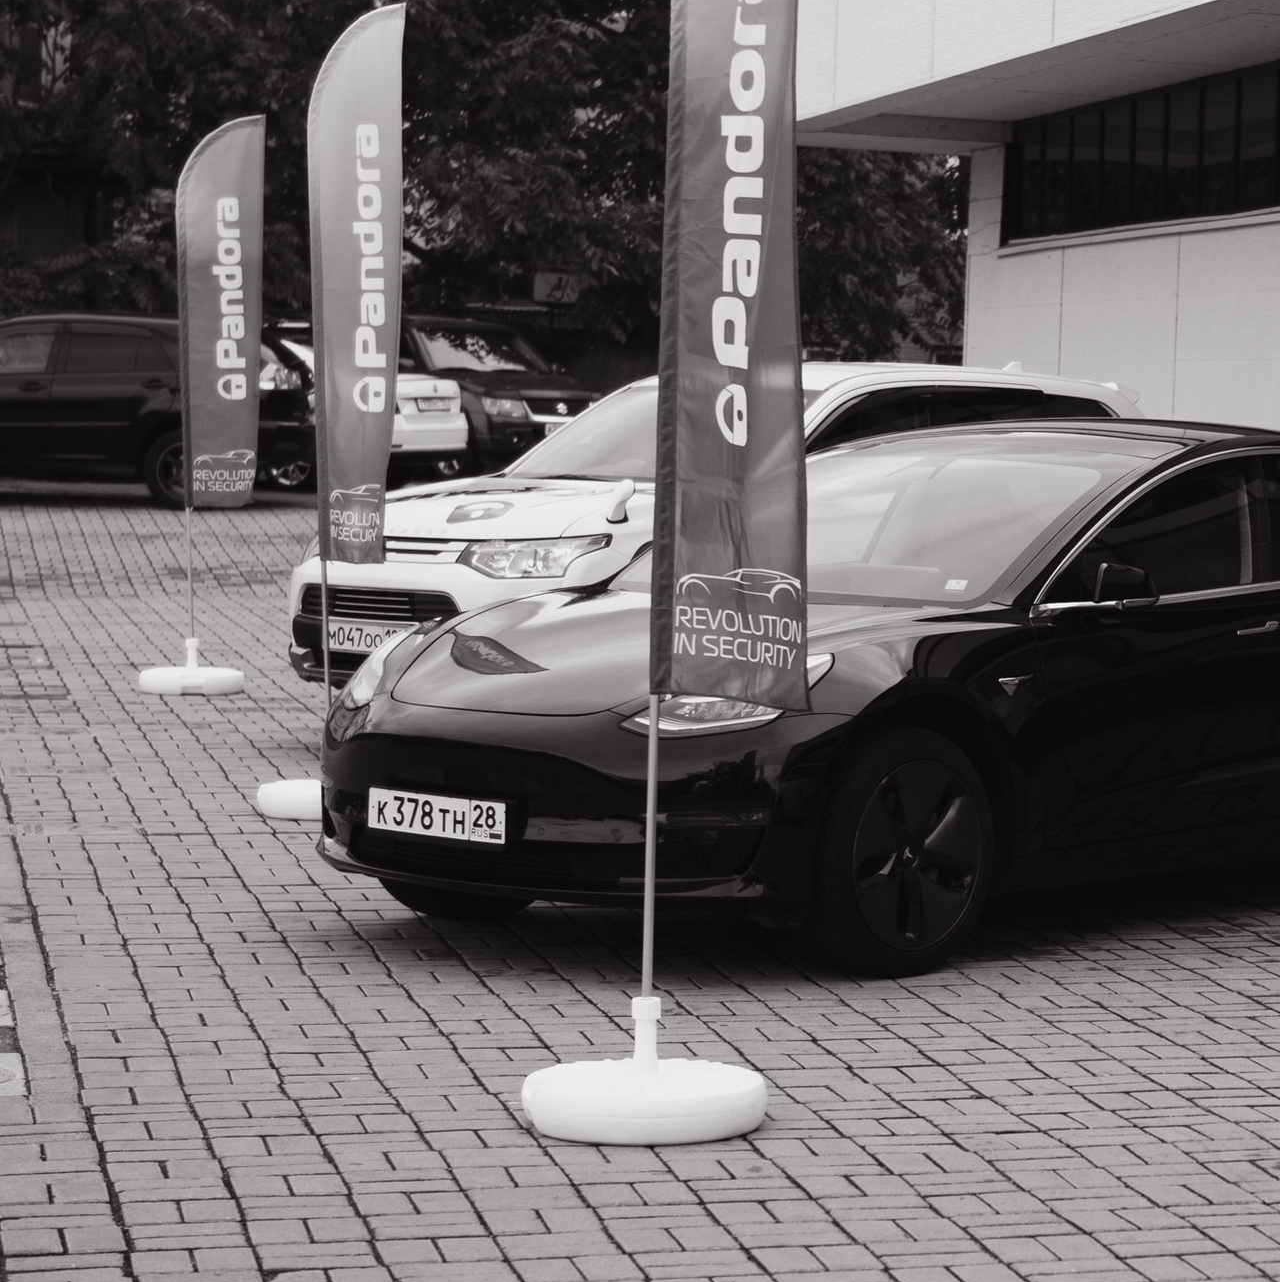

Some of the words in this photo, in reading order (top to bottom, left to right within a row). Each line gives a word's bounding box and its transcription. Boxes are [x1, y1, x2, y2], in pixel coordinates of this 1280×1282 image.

[353, 123, 387, 368] Pandora
[212, 197, 246, 368] Pandora
[193, 468, 256, 481] REVOLUTION
[193, 481, 206, 492] IN
[207, 480, 254, 492] SECURITY
[674, 605, 803, 645] REVOLUTION
[673, 632, 697, 656] IN
[701, 635, 797, 670] SECURITY
[377, 795, 466, 835] К378ТН
[472, 804, 497, 830] 28
[471, 828, 489, 838] RUS
